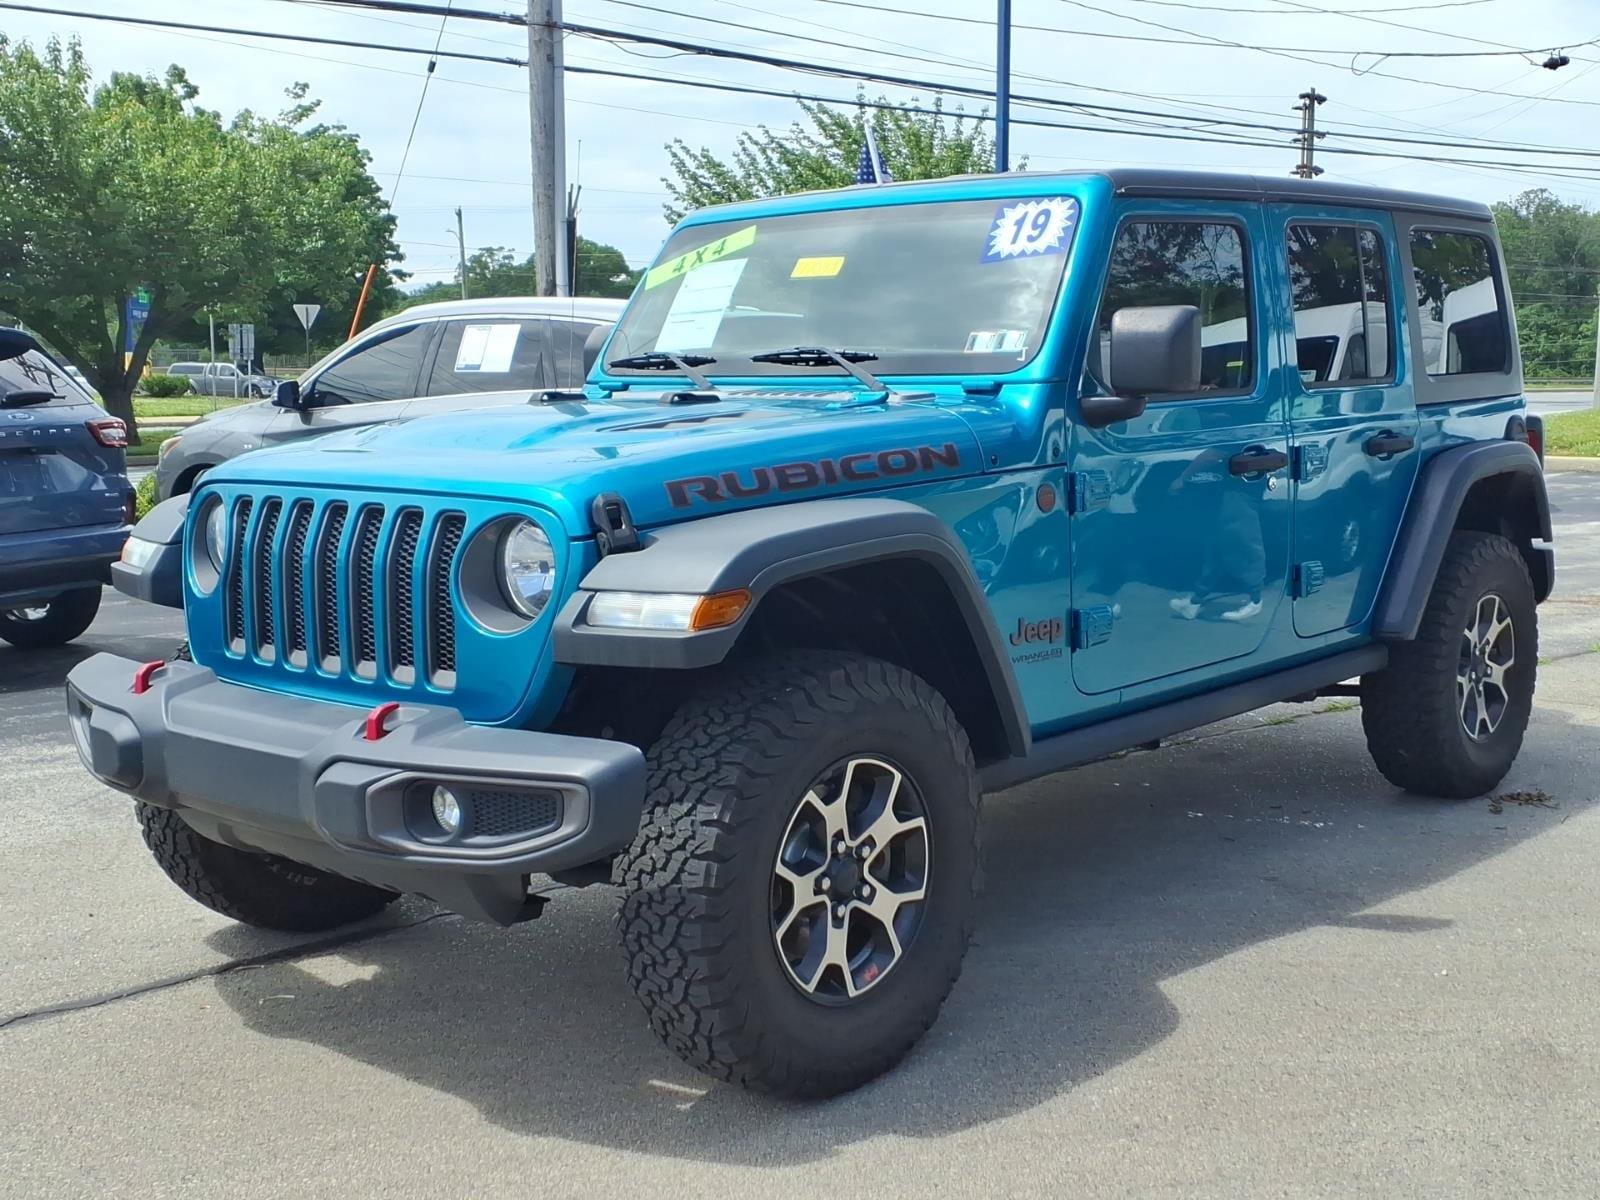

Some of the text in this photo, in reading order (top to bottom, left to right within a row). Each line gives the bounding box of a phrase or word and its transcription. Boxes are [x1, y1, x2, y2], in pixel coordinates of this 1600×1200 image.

[1010, 208, 1052, 245] 19
[665, 442, 960, 508] RUBICON
[1009, 616, 1063, 646] Jeep
[1011, 647, 1063, 664] WRANGLER
